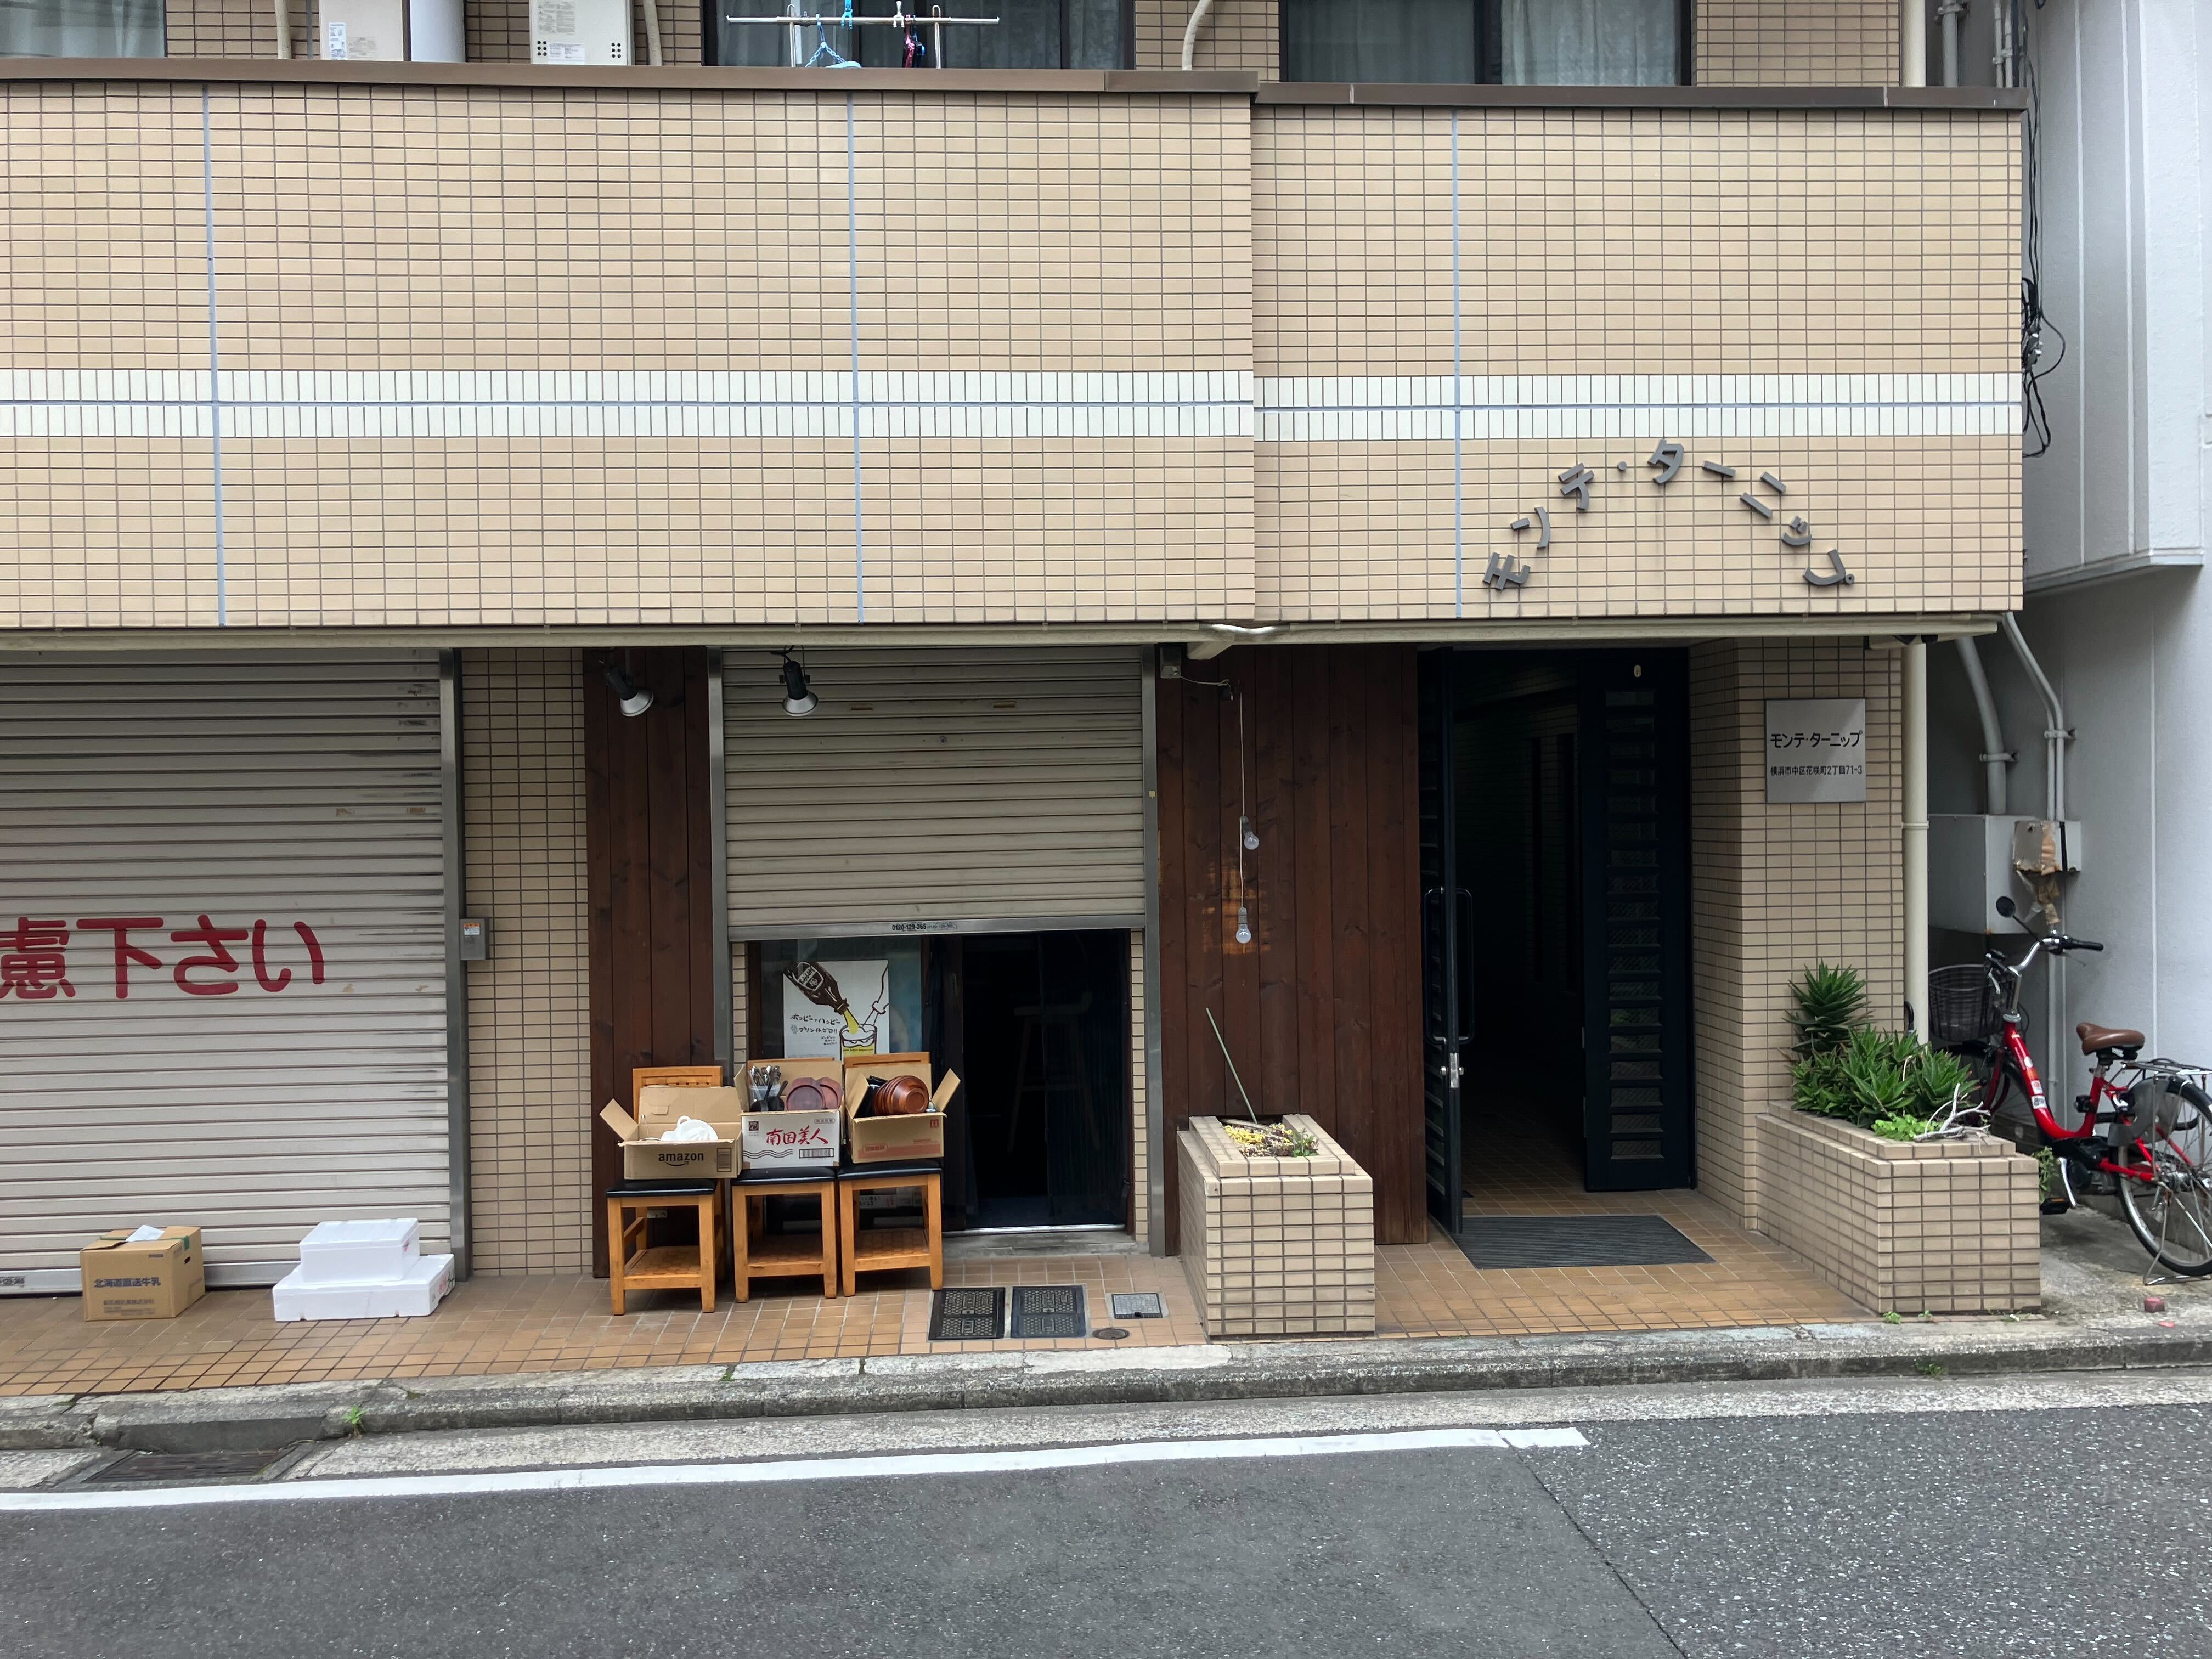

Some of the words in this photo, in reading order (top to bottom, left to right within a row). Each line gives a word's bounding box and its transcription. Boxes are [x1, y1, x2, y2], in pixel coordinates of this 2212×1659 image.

[658, 1153, 704, 1161] amazon
[94, 1277, 161, 1288] 北海道直送牛乳
